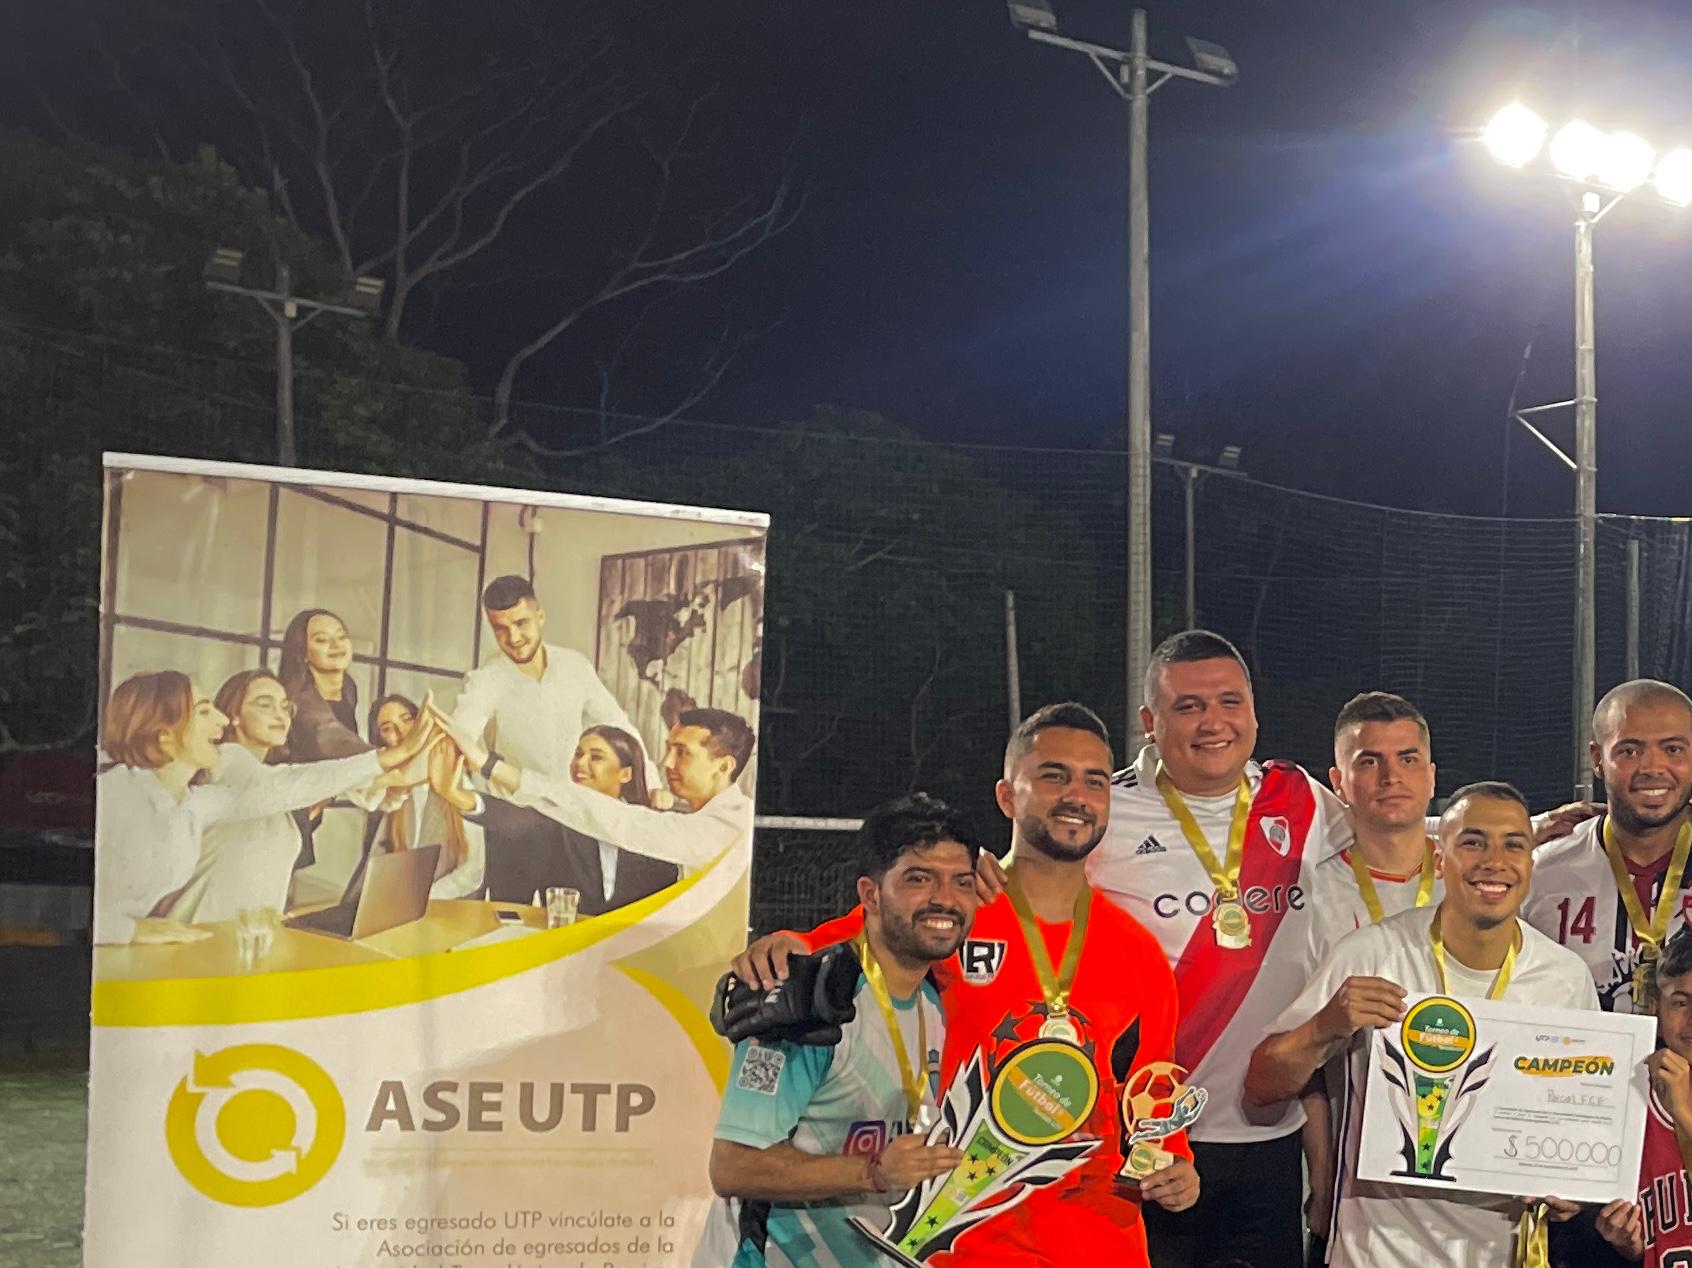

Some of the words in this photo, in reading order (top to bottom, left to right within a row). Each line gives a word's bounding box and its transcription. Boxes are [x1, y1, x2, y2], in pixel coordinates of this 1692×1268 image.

[1154, 885, 1305, 918] coere
[1557, 896, 1597, 945] 14
[1514, 1056, 1615, 1076] CAMPEÓN
[332, 1212, 349, 1231] Si
[357, 1217, 397, 1231] eres
[405, 1212, 497, 1235] egresado
[504, 1211, 542, 1228] UTP
[549, 1210, 632, 1228] vincúlate
[640, 1216, 650, 1228] a
[658, 1210, 675, 1228] la
[376, 1238, 485, 1258] Asociación
[492, 1238, 516, 1256] de
[523, 1237, 620, 1260] egresados
[627, 1236, 650, 1253] de
[657, 1235, 674, 1253] la
